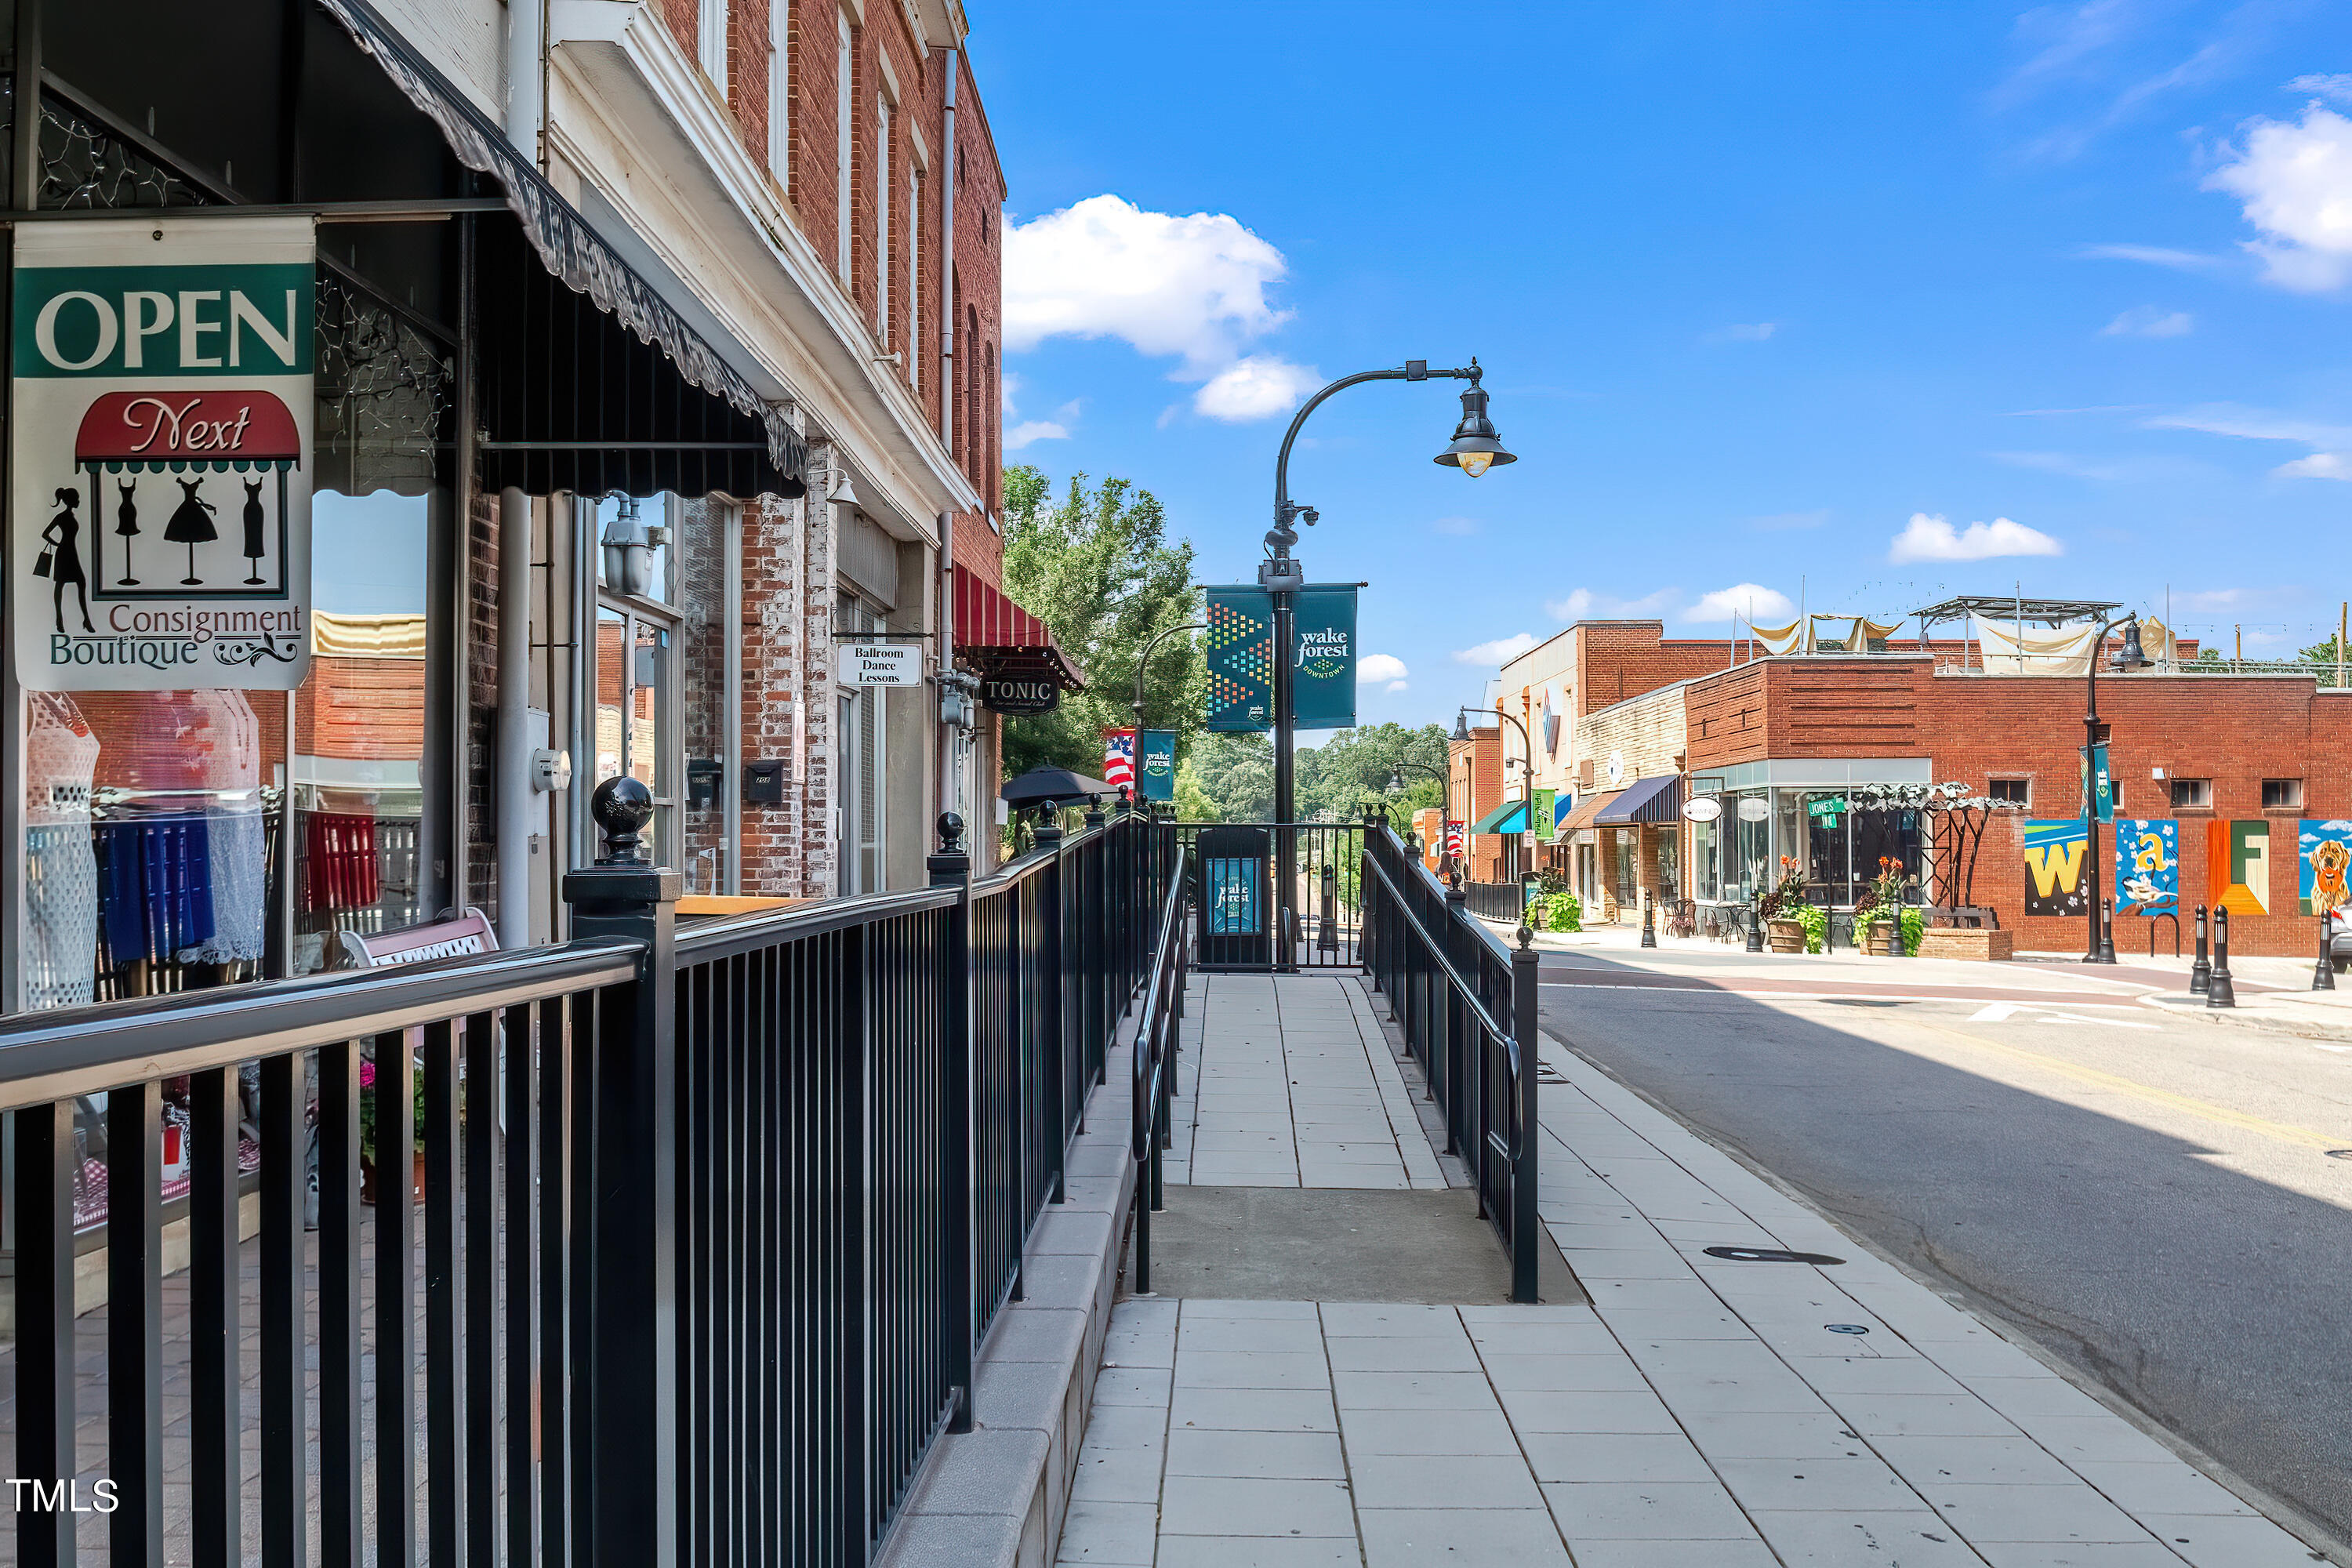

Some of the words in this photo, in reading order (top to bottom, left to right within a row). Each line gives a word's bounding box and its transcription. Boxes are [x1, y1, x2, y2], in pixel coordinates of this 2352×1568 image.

[35, 289, 296, 371] OPEN
[123, 398, 251, 452] Next
[109, 604, 301, 643] Consignment
[1301, 627, 1348, 644] wake
[50, 633, 198, 670] Boutique
[855, 648, 904, 659] Ballroom
[1294, 642, 1349, 668] forest
[862, 659, 896, 670] Dance
[1303, 664, 1345, 679] DOWNTOWN
[858, 672, 900, 683] Lessons
[986, 681, 1051, 699] TONIC
[1146, 751, 1171, 760] wake
[1143, 758, 1171, 771] forest
[1810, 800, 1834, 815] JONES
[2230, 821, 2270, 884] F
